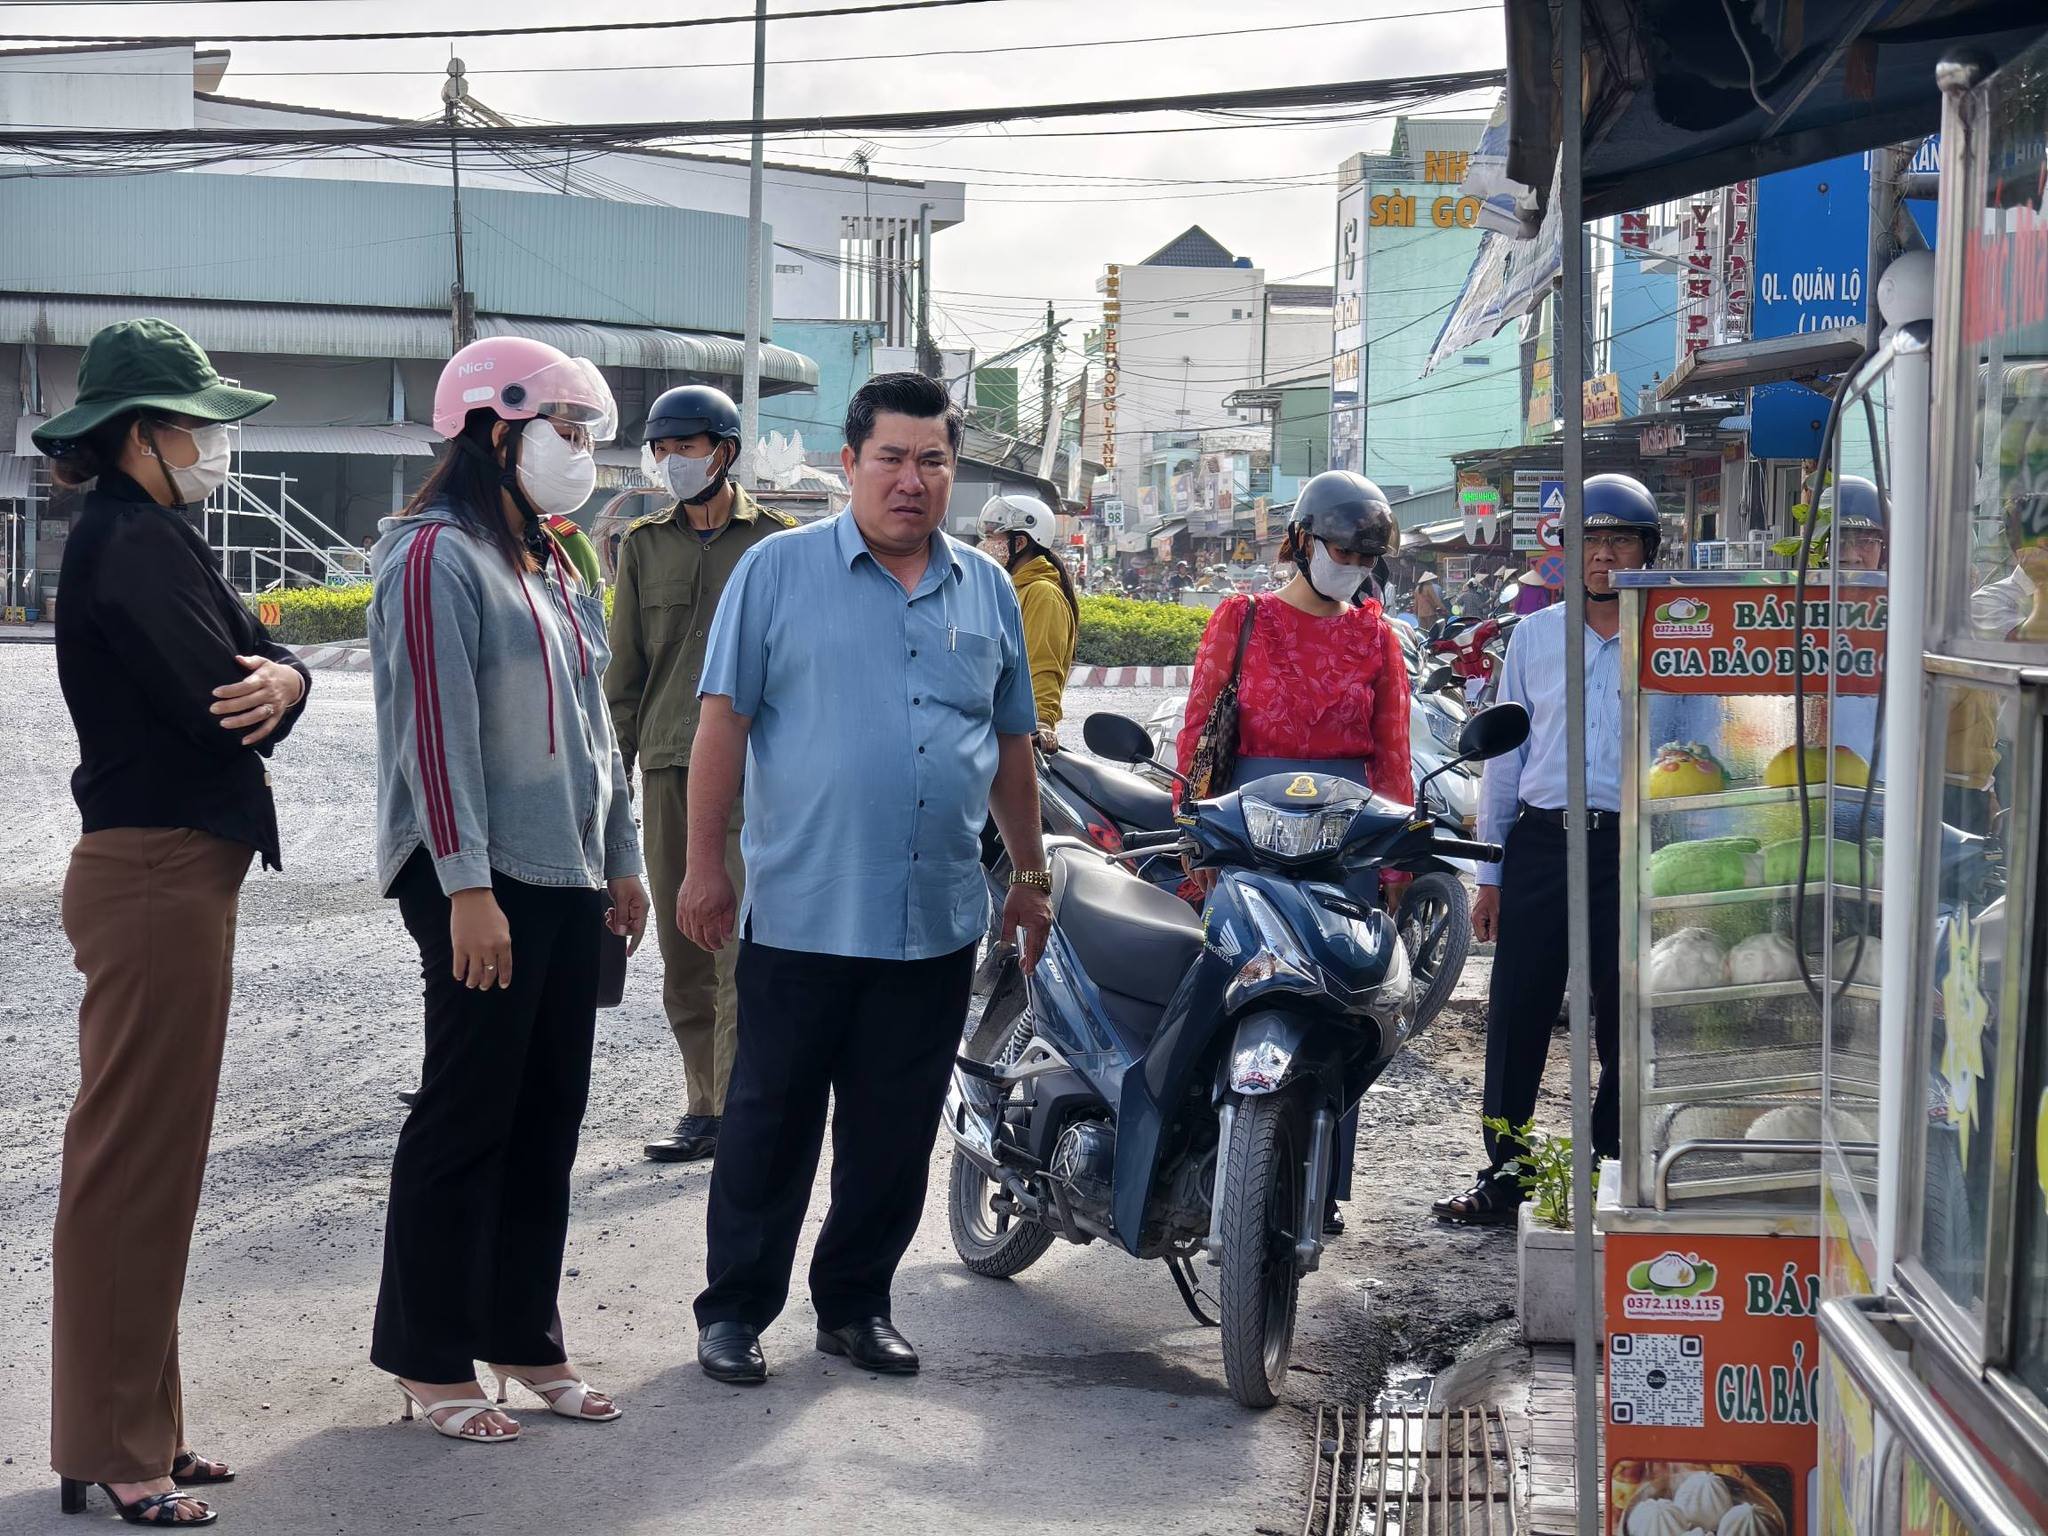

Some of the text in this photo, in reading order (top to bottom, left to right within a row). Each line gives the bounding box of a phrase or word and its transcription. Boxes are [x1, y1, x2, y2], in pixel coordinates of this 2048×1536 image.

[1424, 150, 1469, 184] NH
[1368, 187, 1481, 229] SÀI GO
[1620, 213, 1650, 249] NH
[1761, 266, 1861, 307] QL. QUẢN LỘ
[1684, 314, 1709, 358] PH
[458, 359, 495, 379] Nice
[1107, 511, 1122, 524] 98
[1654, 624, 1713, 633] 0372.119.115
[1652, 648, 1706, 676] GIA
[1709, 637, 1772, 676] BẢO
[1206, 940, 1234, 967] HONDA
[1626, 1297, 1721, 1311] 0372.119.115
[1746, 1262, 1821, 1315] BÁN
[1716, 1365, 1766, 1424] GIA
